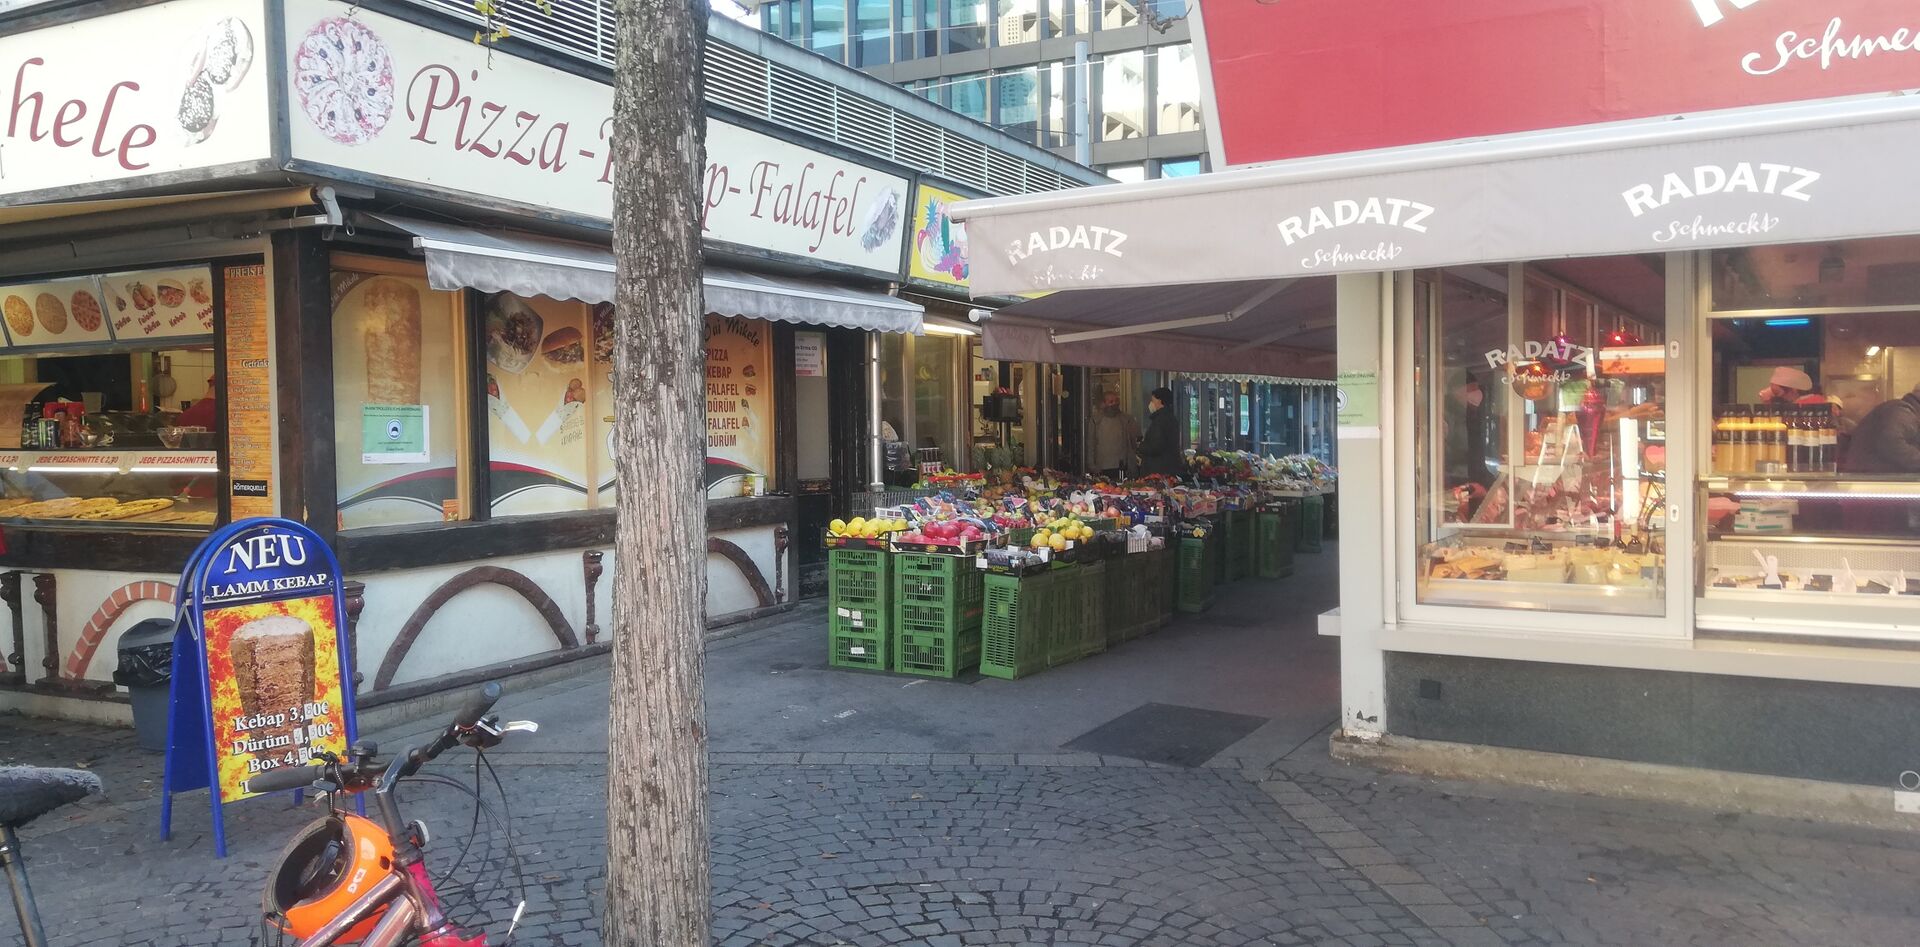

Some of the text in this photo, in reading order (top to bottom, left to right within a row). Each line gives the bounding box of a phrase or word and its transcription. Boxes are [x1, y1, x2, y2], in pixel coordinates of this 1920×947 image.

[1622, 162, 1821, 218] RADATZ
[1276, 196, 1435, 247] RADATZ
[1005, 224, 1128, 267] RADATZ
[706, 348, 729, 362] PIZZA
[1485, 340, 1590, 369] RADATZ
[706, 366, 731, 379] KEBAP
[707, 383, 739, 396] FALAFEL
[707, 398, 736, 413] DÜRÜM
[708, 417, 740, 430] FALAFEL
[708, 432, 737, 448] DÜRÜM
[139, 456, 156, 464] JEDE
[156, 456, 209, 464] PIZZASCHNITTE
[224, 534, 307, 574] NEU
[211, 573, 328, 598] LAMM KEBAP
[233, 713, 285, 732] Kebap
[232, 734, 290, 756] Dürüm
[248, 758, 279, 773] Box
